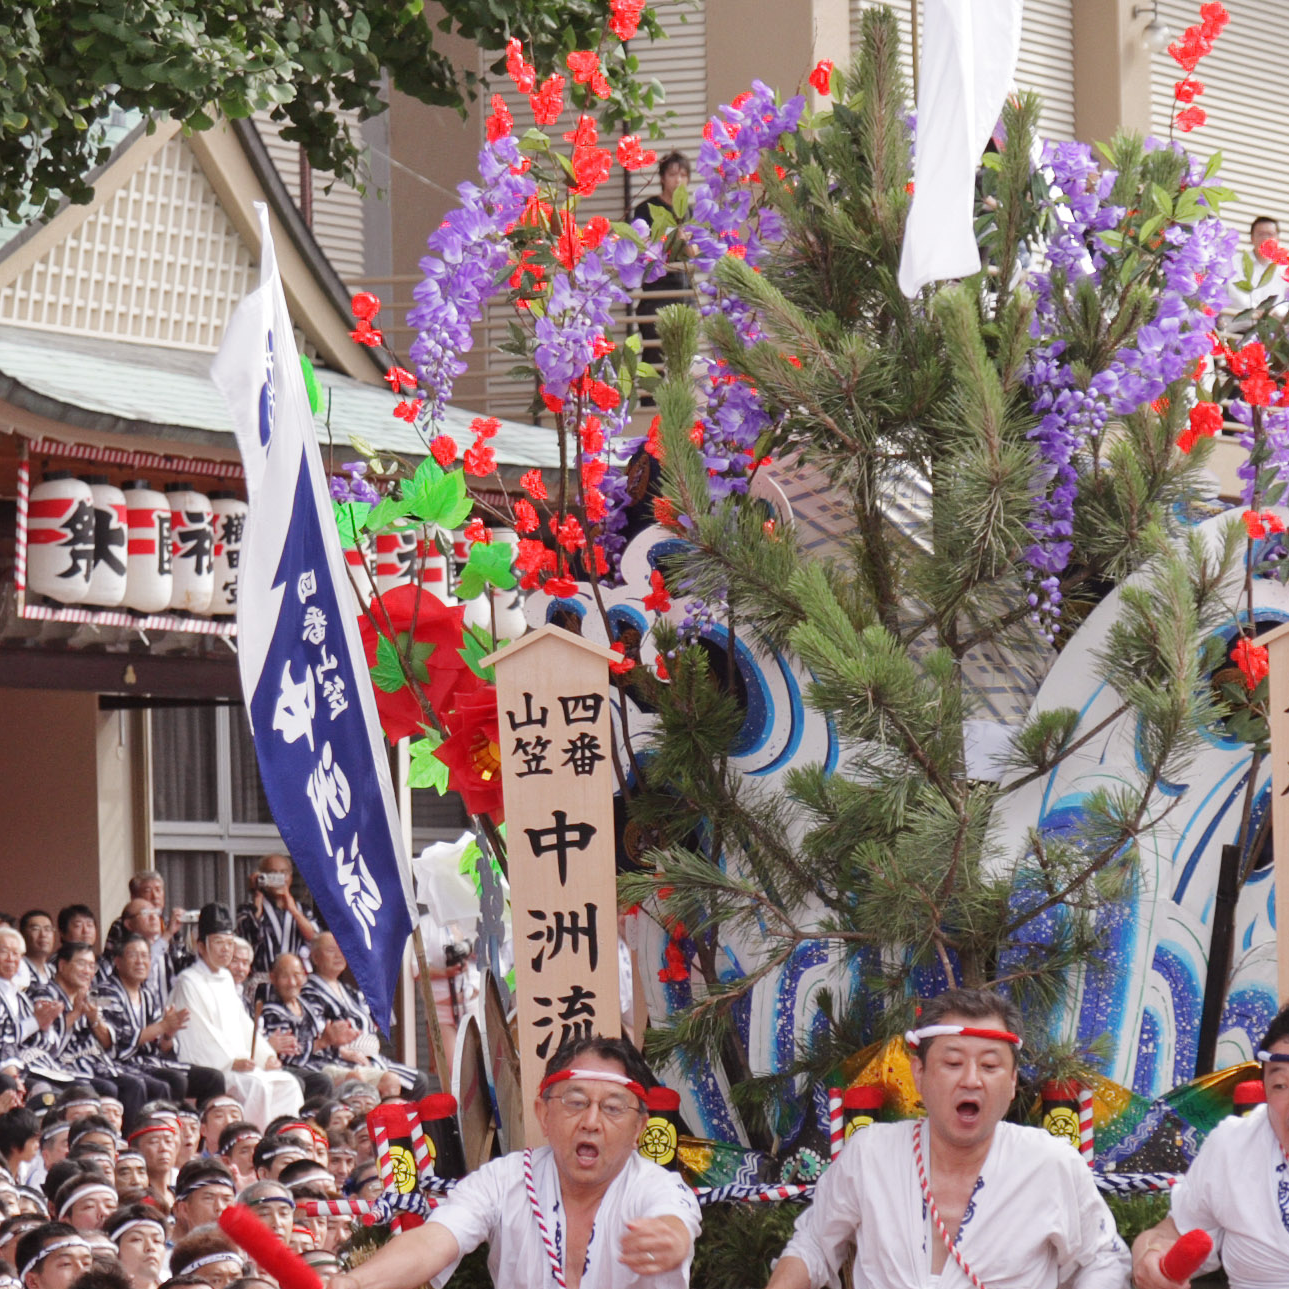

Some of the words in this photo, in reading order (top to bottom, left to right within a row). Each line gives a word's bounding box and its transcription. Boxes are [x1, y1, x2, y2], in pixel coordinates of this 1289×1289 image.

[55, 500, 95, 583] 祭
[506, 691, 554, 778] 山笠
[558, 692, 606, 777] 四番
[523, 810, 599, 1060] 中洲流
